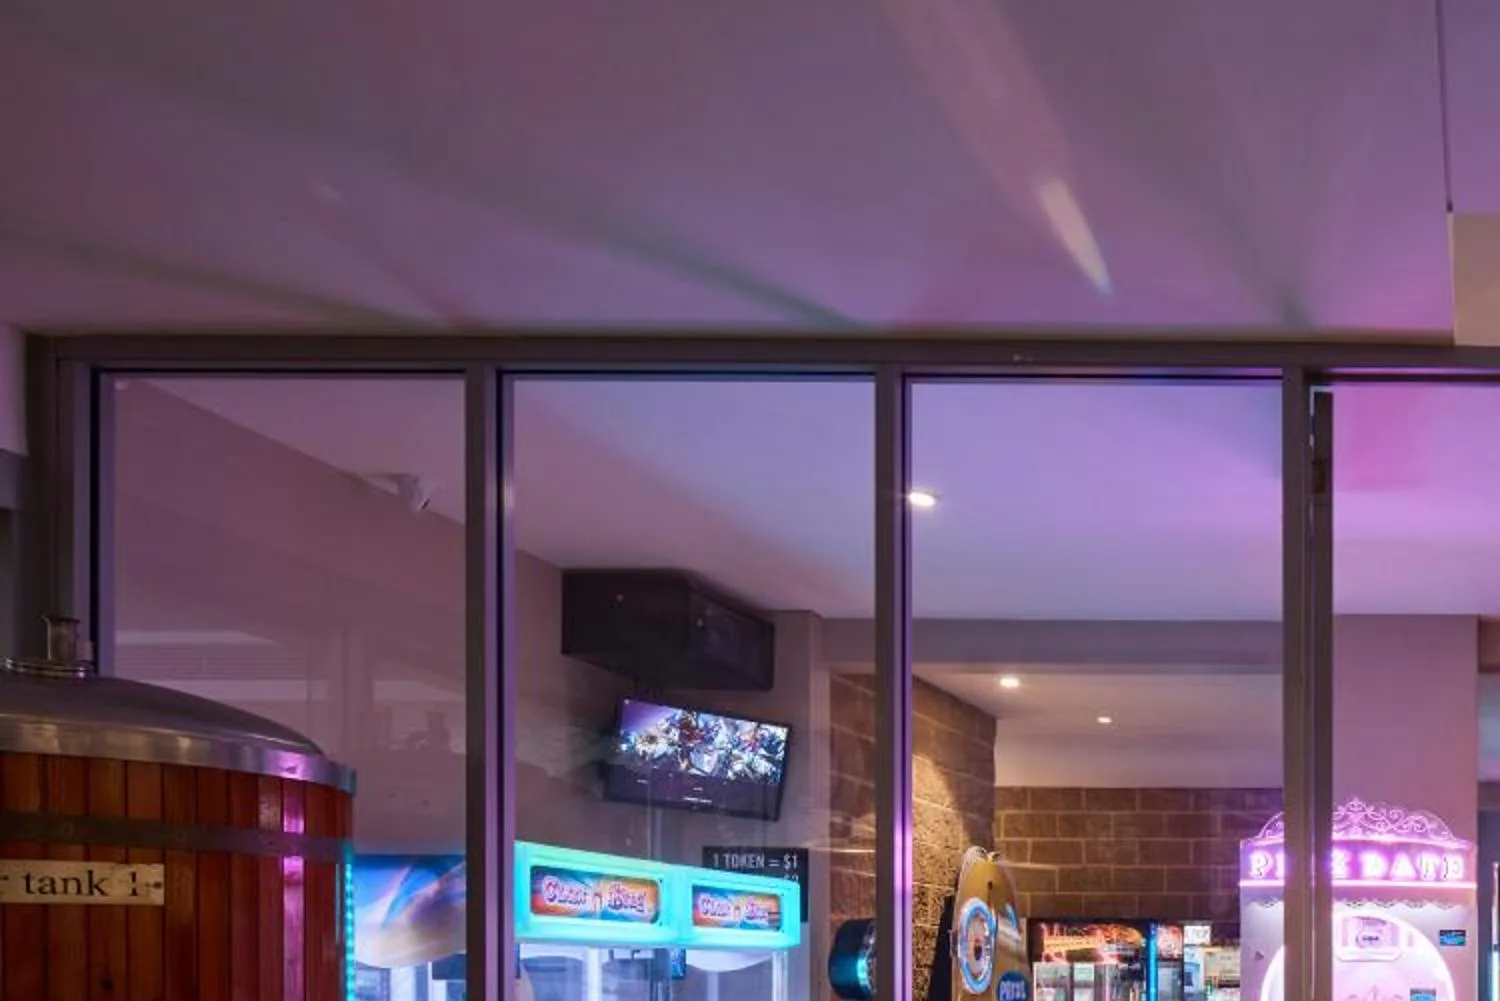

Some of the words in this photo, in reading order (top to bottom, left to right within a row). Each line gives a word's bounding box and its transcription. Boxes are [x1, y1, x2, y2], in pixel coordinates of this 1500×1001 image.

[723, 852, 765, 869] TOKEN
[783, 852, 798, 870] $1
[1249, 851, 1350, 881] PIK
[1360, 850, 1466, 882] DATE
[23, 869, 111, 896] tank
